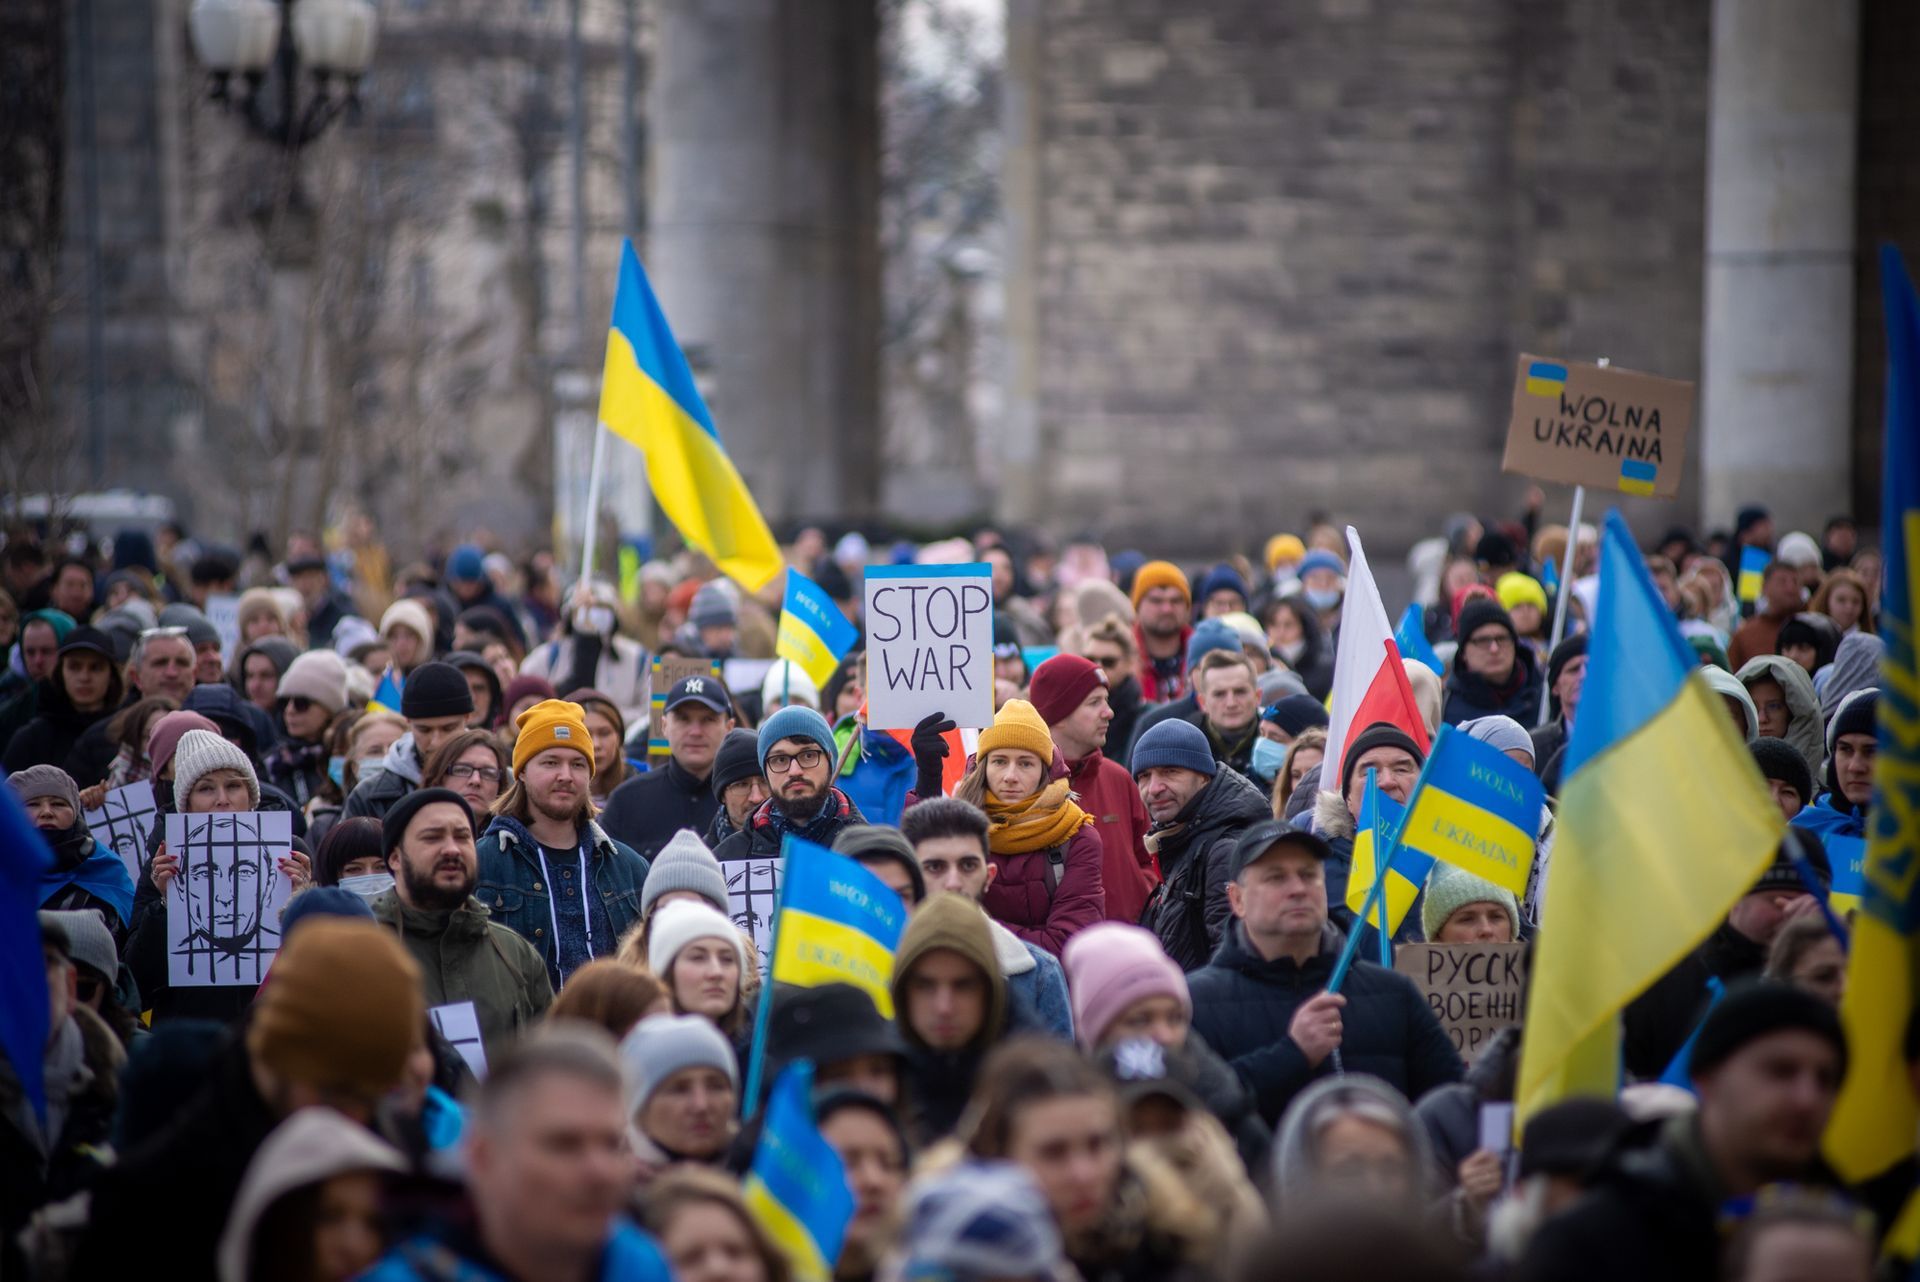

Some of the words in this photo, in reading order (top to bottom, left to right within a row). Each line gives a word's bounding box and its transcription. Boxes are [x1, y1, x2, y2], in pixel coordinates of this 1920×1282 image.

[1560, 392, 1661, 434] WOLNA
[1534, 417, 1662, 463] UKRAINA
[873, 585, 989, 642] STOP
[882, 645, 972, 691] WAR
[1470, 761, 1524, 806] WOLNA
[1433, 816, 1518, 869] UKRAINA
[1428, 950, 1519, 986] РУССК
[1428, 992, 1516, 1021] ВОЕНН
